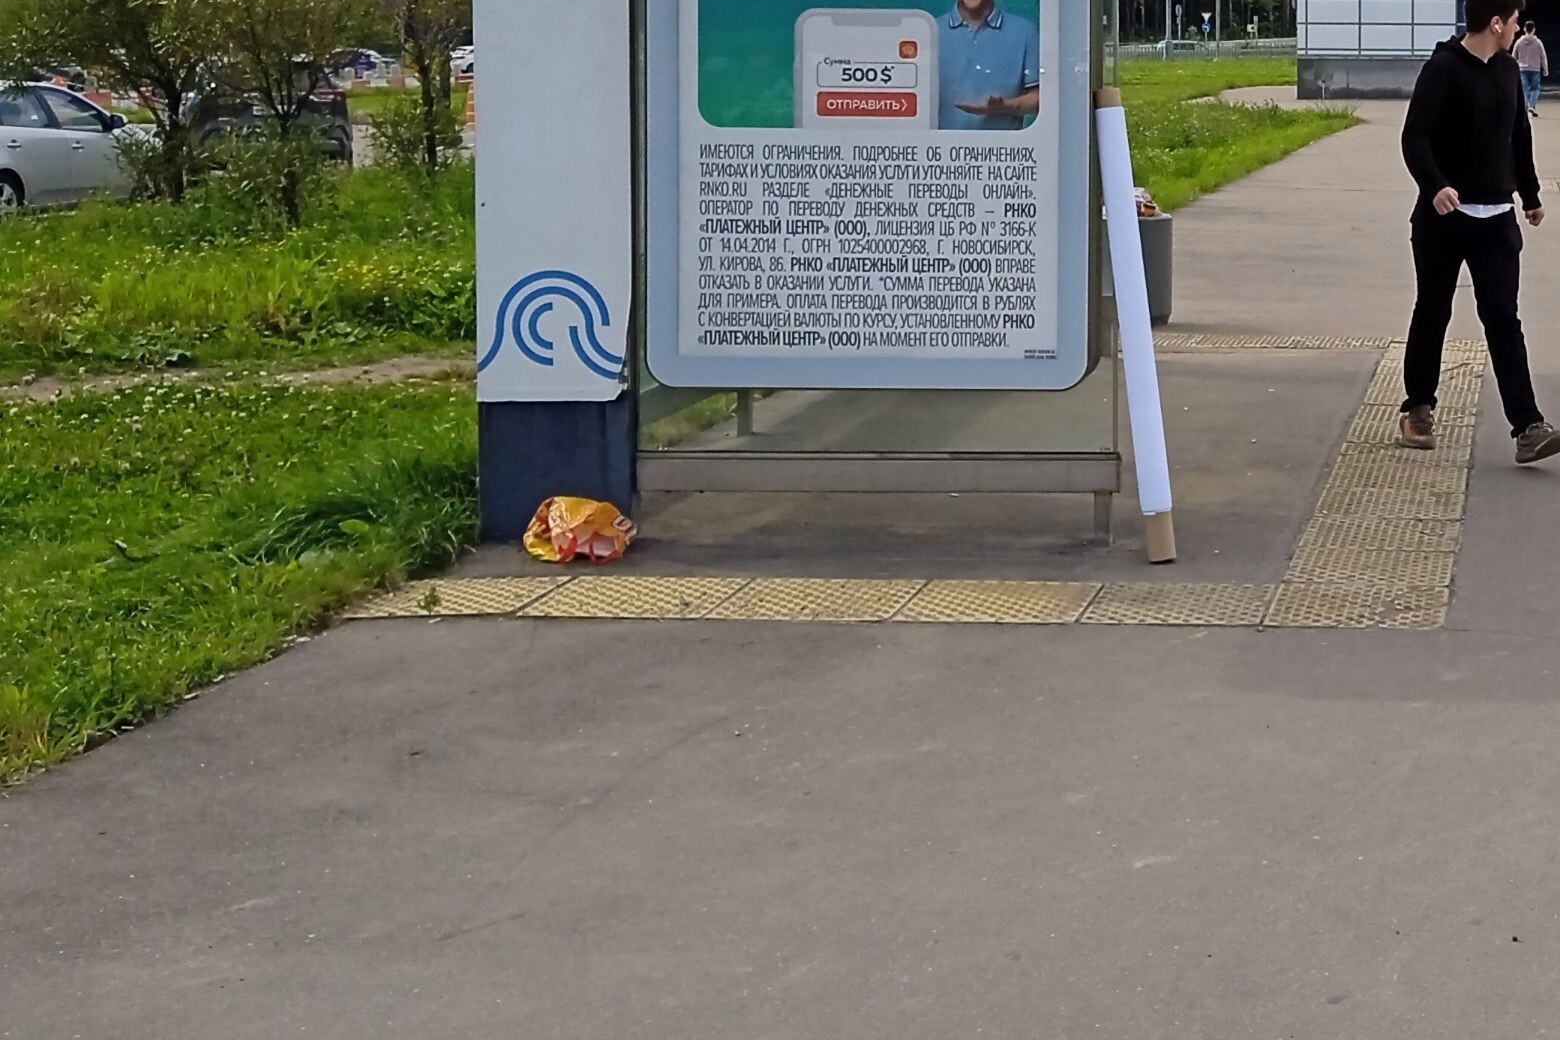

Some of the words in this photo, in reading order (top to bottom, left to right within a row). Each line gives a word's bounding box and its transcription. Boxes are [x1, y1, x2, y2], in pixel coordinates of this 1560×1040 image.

[824, 57, 851, 66] Сумма
[826, 99, 900, 110] ОТПРАВИТЬ
[700, 144, 754, 160] ИМЕЮТСЯ
[762, 144, 844, 160] ОГРАНИЧЕНИЯ.
[853, 146, 918, 163] ПОДРОБНЕЕ
[926, 146, 942, 161] ОБ
[950, 147, 1037, 164] ОГРАНИЧЕНИЯХ,
[700, 163, 749, 178] ТАРИФАХ
[750, 164, 758, 178] И
[760, 164, 818, 179] УСЛОВИЯХ
[820, 164, 876, 180] ОКАЗАНИЯ
[878, 164, 920, 180] УСЛУГИ
[922, 163, 982, 181] УТОЧНЯЙТЕ
[988, 166, 1004, 180] НА
[1004, 164, 1037, 181] САЙТЕ
[700, 182, 747, 197] RNKO.RU
[762, 182, 810, 199] РАЗДЕЛЕ
[824, 182, 893, 200] «ДЕНЕЖНЫЕ
[908, 184, 968, 200] ПЕРЕВОДЫ
[983, 182, 1037, 200] ОНЛАЙН».
[700, 200, 753, 216] ОПЕРАТОР
[763, 201, 778, 216] ПО
[789, 201, 845, 218] ПЕРЕВОДУ
[854, 202, 918, 218] ДЕНЕЖНЫХ
[928, 202, 975, 218] СРЕДСТВ
[1004, 203, 1037, 218] РНКО
[700, 217, 782, 235] «ПЛАТЕЖНЫЙ
[786, 220, 830, 236] ЦЕНТР»
[834, 220, 870, 238] (ООО),
[875, 221, 934, 238] ЛИЦЕНЗИЯ
[939, 221, 954, 238] ЦБ
[959, 222, 977, 236] РФ
[699, 237, 712, 252] ОТ
[720, 238, 776, 252] 14.04.2014
[802, 238, 830, 254] ОГРН
[838, 239, 930, 255] 1025400002968,
[938, 240, 944, 254] Г.
[952, 240, 1036, 256] НОВОСИБИРСК,
[698, 256, 715, 272] УЛ.
[720, 256, 766, 273] КИРОВА,
[770, 256, 786, 272] 86.
[790, 257, 823, 272] РНКО
[826, 255, 908, 273] «ПЛАТЕЖНЫЙ
[912, 258, 956, 275] ЦЕНТР»
[959, 258, 992, 276] (ООО)
[995, 259, 1036, 274] ВПРАВЕ
[699, 275, 750, 290] ОТКАЗАТЬ
[754, 276, 762, 290] В
[767, 276, 824, 290] ОКАЗАНИИ
[829, 276, 873, 291] УСЛУГИ.
[929, 276, 984, 294] ПЕРЕВОДА
[988, 277, 1036, 292] УКАЗАНА
[698, 294, 722, 310] ДЛЯ
[727, 294, 781, 309] ПРИМЕРА.
[786, 294, 828, 309] ОПЛАТА
[832, 294, 887, 310] ПЕРЕВОДА
[892, 295, 977, 312] ПРОИЗВОДИТСЯ
[982, 296, 990, 310] В
[995, 296, 1036, 310] РУБЛЯХ
[698, 312, 706, 326] С
[708, 310, 790, 329] КОНВЕРТАЦИЕЙ
[794, 313, 841, 328] ВАЛЮТЫ
[844, 314, 860, 328] ПО
[863, 314, 898, 330] КУРСУ,
[900, 314, 1000, 330] УСТАНОВЛЕННОМУ
[1003, 314, 1035, 329] РНКО
[698, 328, 780, 346] «ПЛАТЕЖНЫЙ
[783, 331, 826, 348] ЦЕНТР»
[828, 332, 860, 350] (ООО)
[863, 332, 878, 346] НА
[880, 332, 928, 347] МОМЕНТ
[930, 333, 950, 347] ЕГО
[951, 333, 1010, 348] ОТПРАВКИ.
